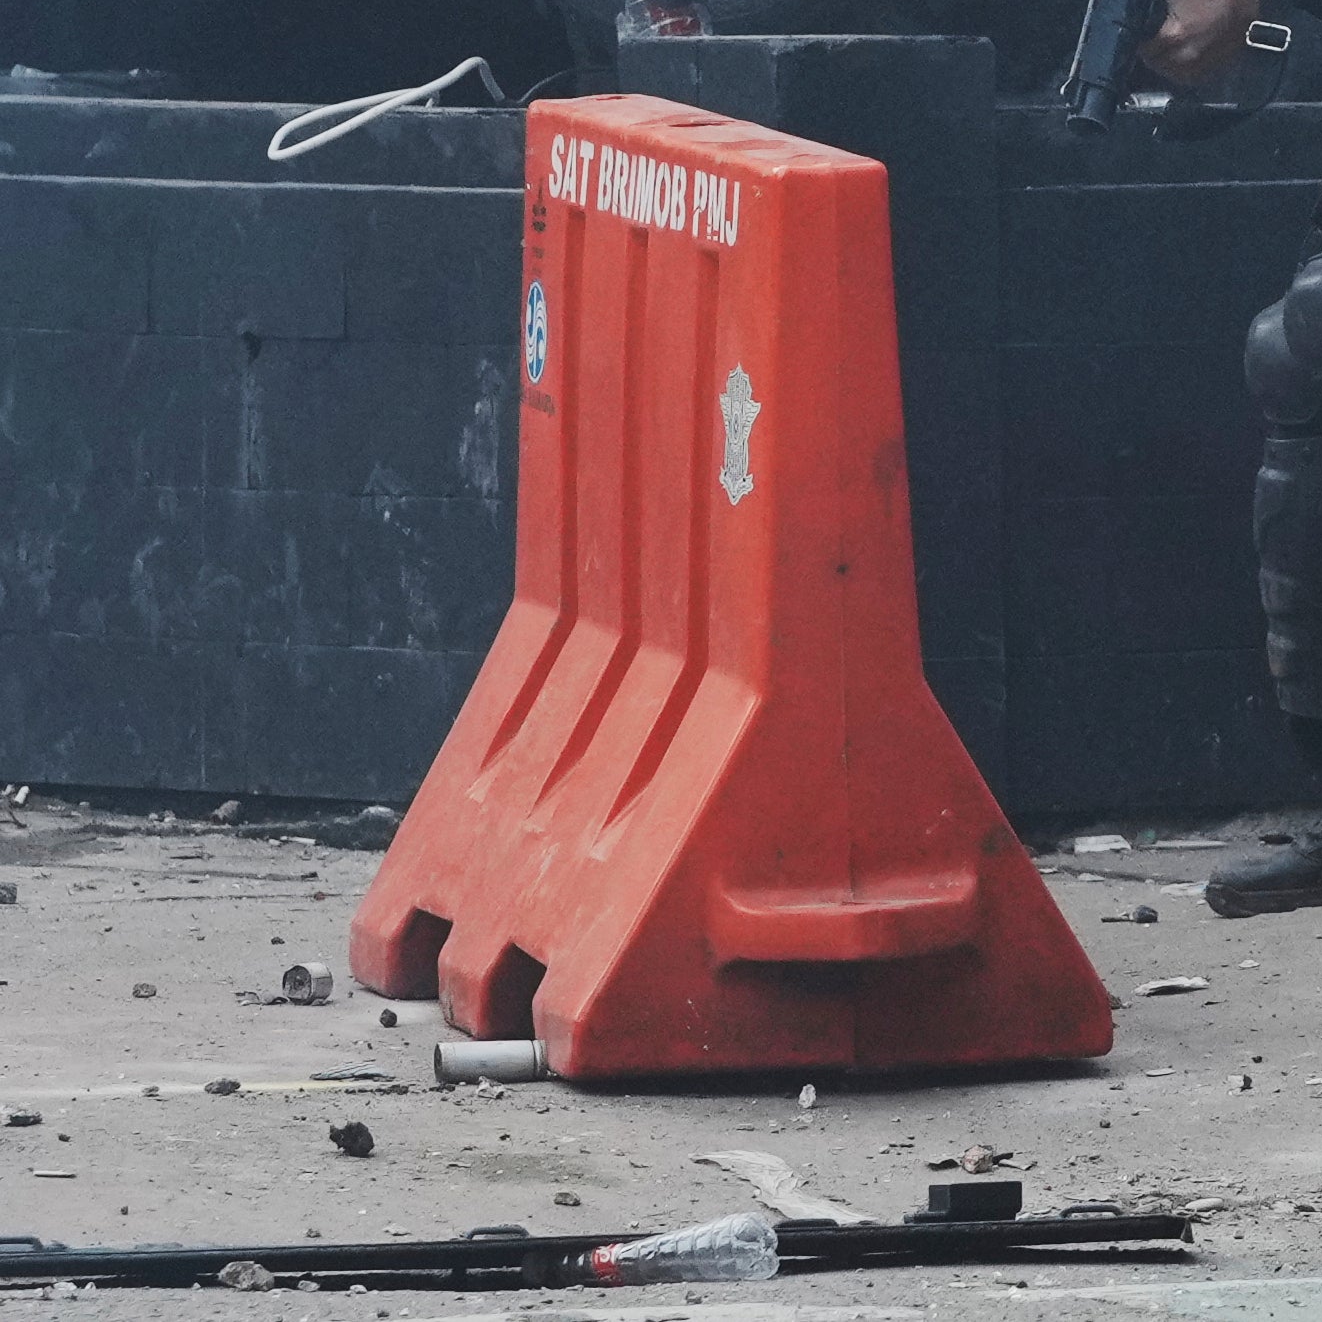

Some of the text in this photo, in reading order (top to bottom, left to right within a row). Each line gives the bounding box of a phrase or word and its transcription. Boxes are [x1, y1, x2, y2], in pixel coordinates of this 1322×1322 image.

[549, 134, 740, 247] SAT BRIMOB PMJ
